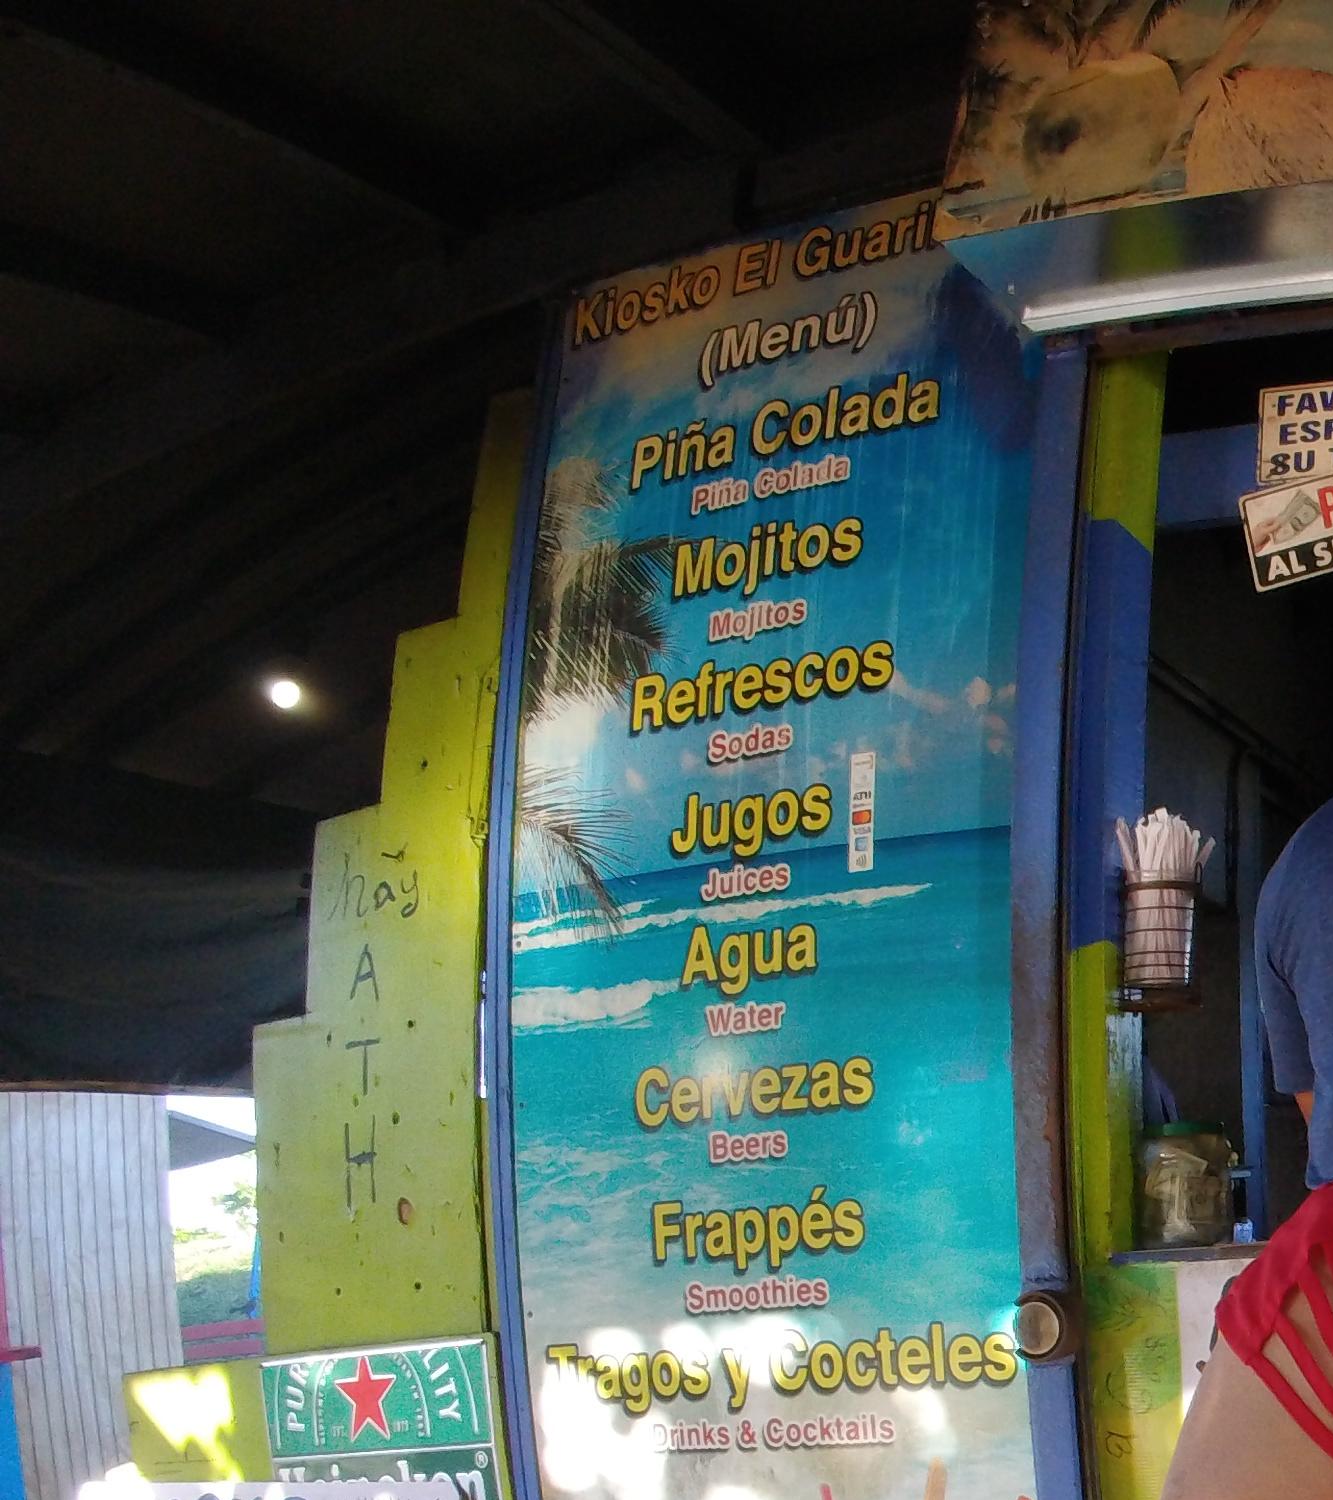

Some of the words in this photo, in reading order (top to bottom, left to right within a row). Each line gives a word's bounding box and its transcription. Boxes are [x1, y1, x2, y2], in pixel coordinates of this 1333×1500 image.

[574, 264, 720, 349] Kiosko
[733, 238, 783, 295] El
[794, 202, 936, 279] Guari
[699, 291, 879, 388] (Menú)
[630, 418, 735, 492] Piña
[751, 372, 942, 457] Colada
[1269, 450, 1316, 478] SU
[691, 476, 749, 516] Piña
[754, 455, 852, 502] Colada
[672, 516, 865, 603] Mojitos
[1267, 550, 1307, 583] AL
[708, 599, 808, 644] Mojitos
[631, 641, 896, 734] Refrescos
[707, 723, 794, 766] Sodas
[671, 783, 833, 860] Jugos
[701, 863, 790, 901] Juices
[681, 922, 819, 996] Agua
[705, 1001, 786, 1036] Water
[634, 1055, 876, 1129] Cervezas
[709, 1131, 788, 1164] Beers
[651, 1186, 867, 1271] Frappés
[686, 1277, 829, 1314] Smoothies
[721, 1346, 752, 1413] y
[769, 1323, 1020, 1394] Cocteles
[652, 1420, 731, 1451] Drinks
[736, 1419, 758, 1449] &
[763, 1414, 896, 1448] Cocktails
